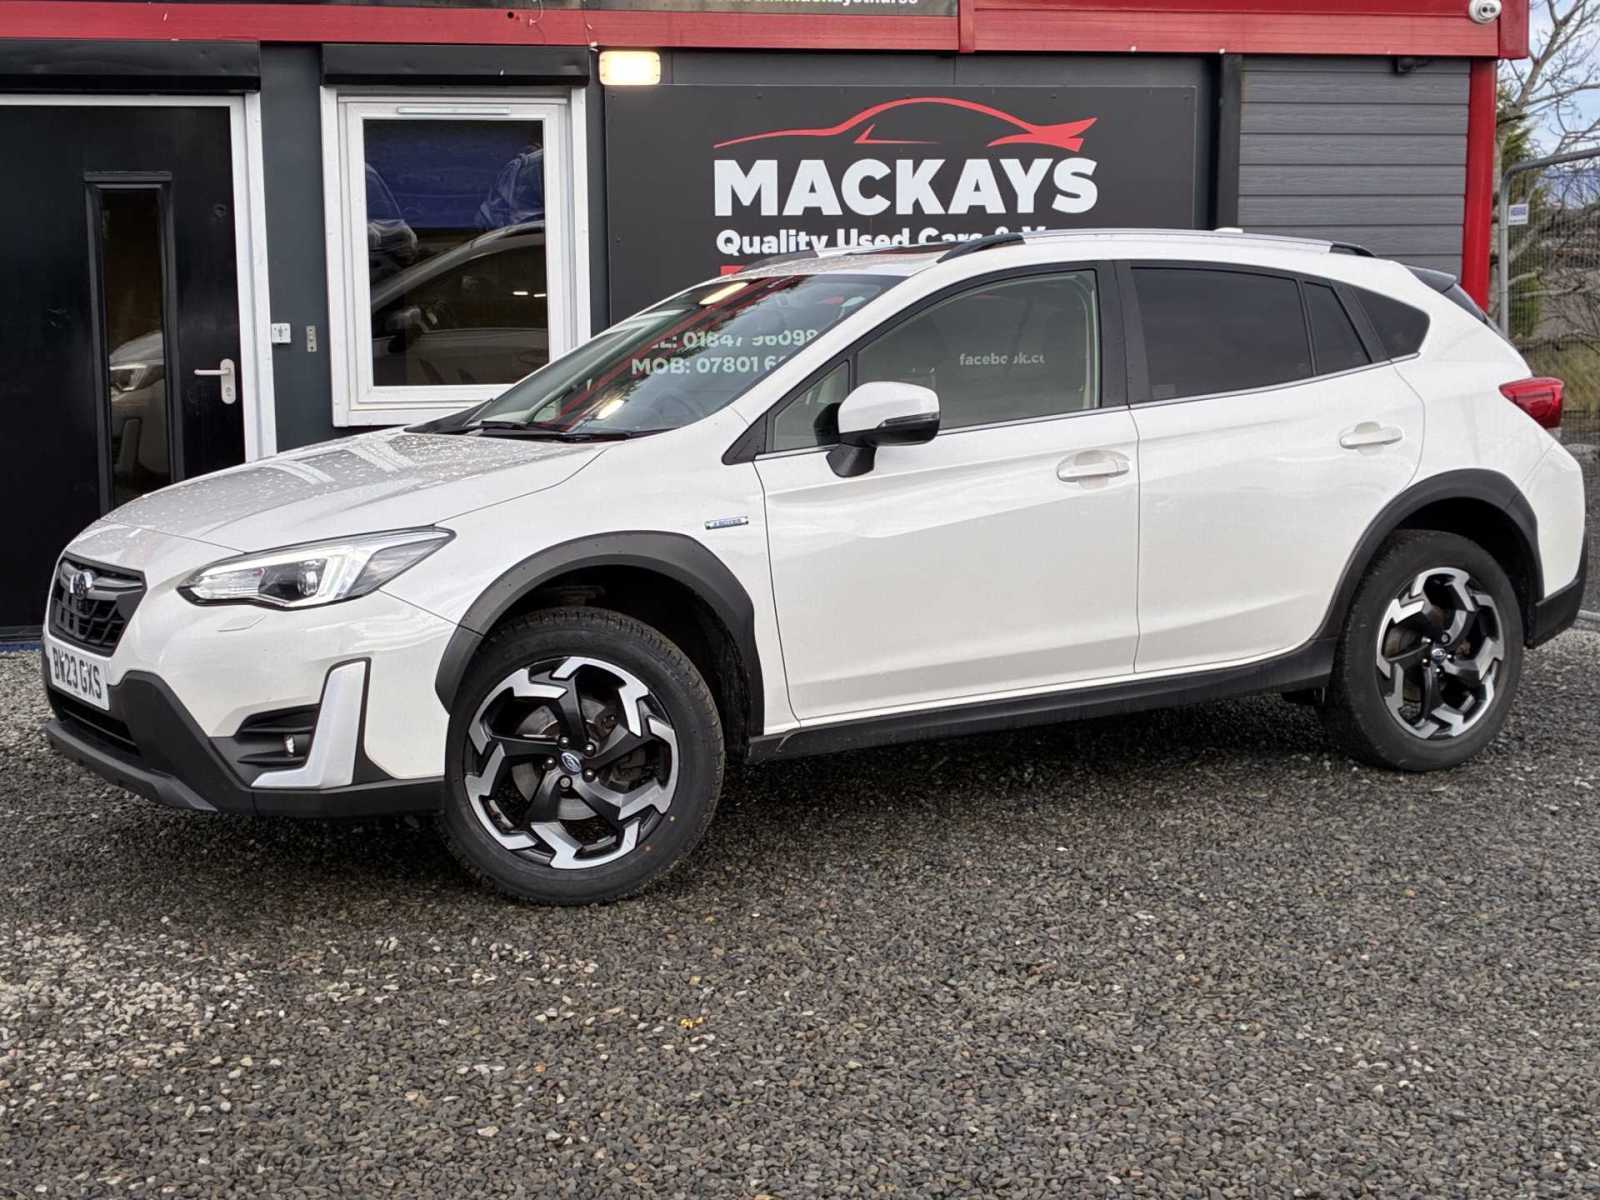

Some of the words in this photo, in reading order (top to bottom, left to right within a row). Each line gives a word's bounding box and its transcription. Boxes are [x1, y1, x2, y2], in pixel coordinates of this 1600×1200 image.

[714, 157, 1098, 216] MACKAYS
[716, 228, 829, 256] Quality
[836, 227, 910, 249] Used
[631, 357, 690, 375] MOB:
[696, 356, 758, 374] 07801
